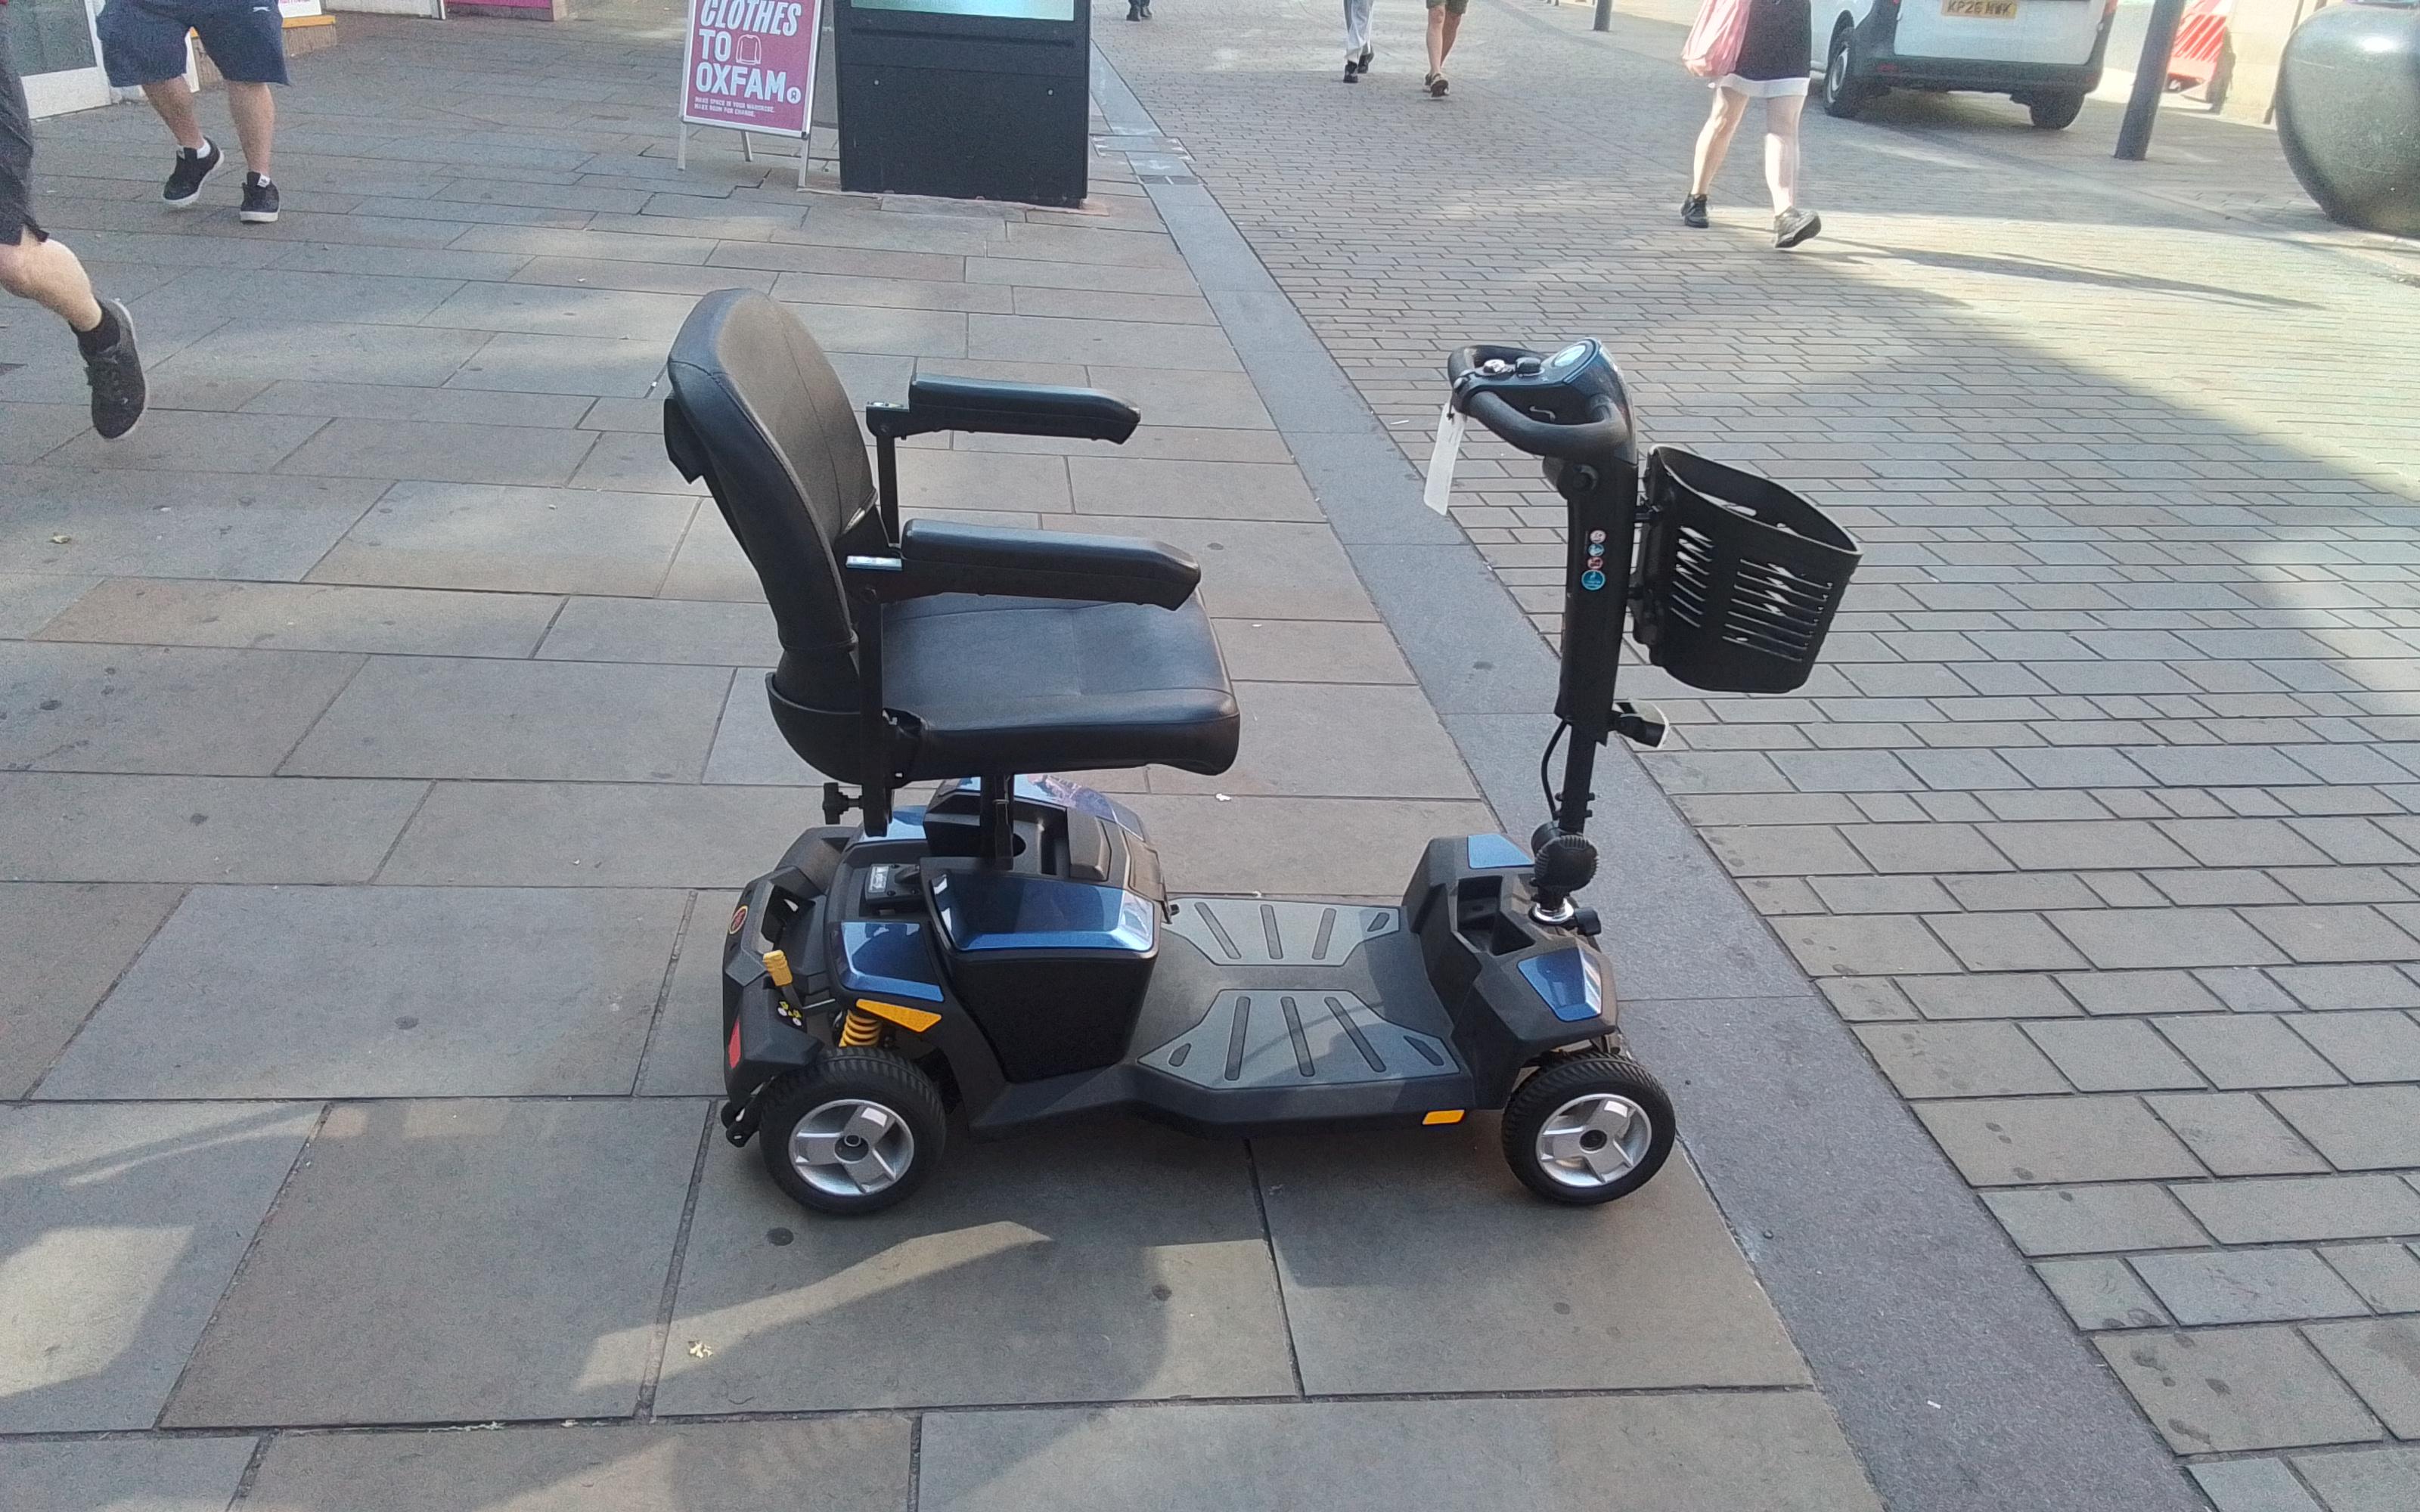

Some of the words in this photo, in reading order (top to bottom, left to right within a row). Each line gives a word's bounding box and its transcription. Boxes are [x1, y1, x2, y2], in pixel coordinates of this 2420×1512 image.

[700, 0, 802, 36] CLOTHES
[699, 29, 731, 62] TO
[696, 62, 786, 102] OXFAM
